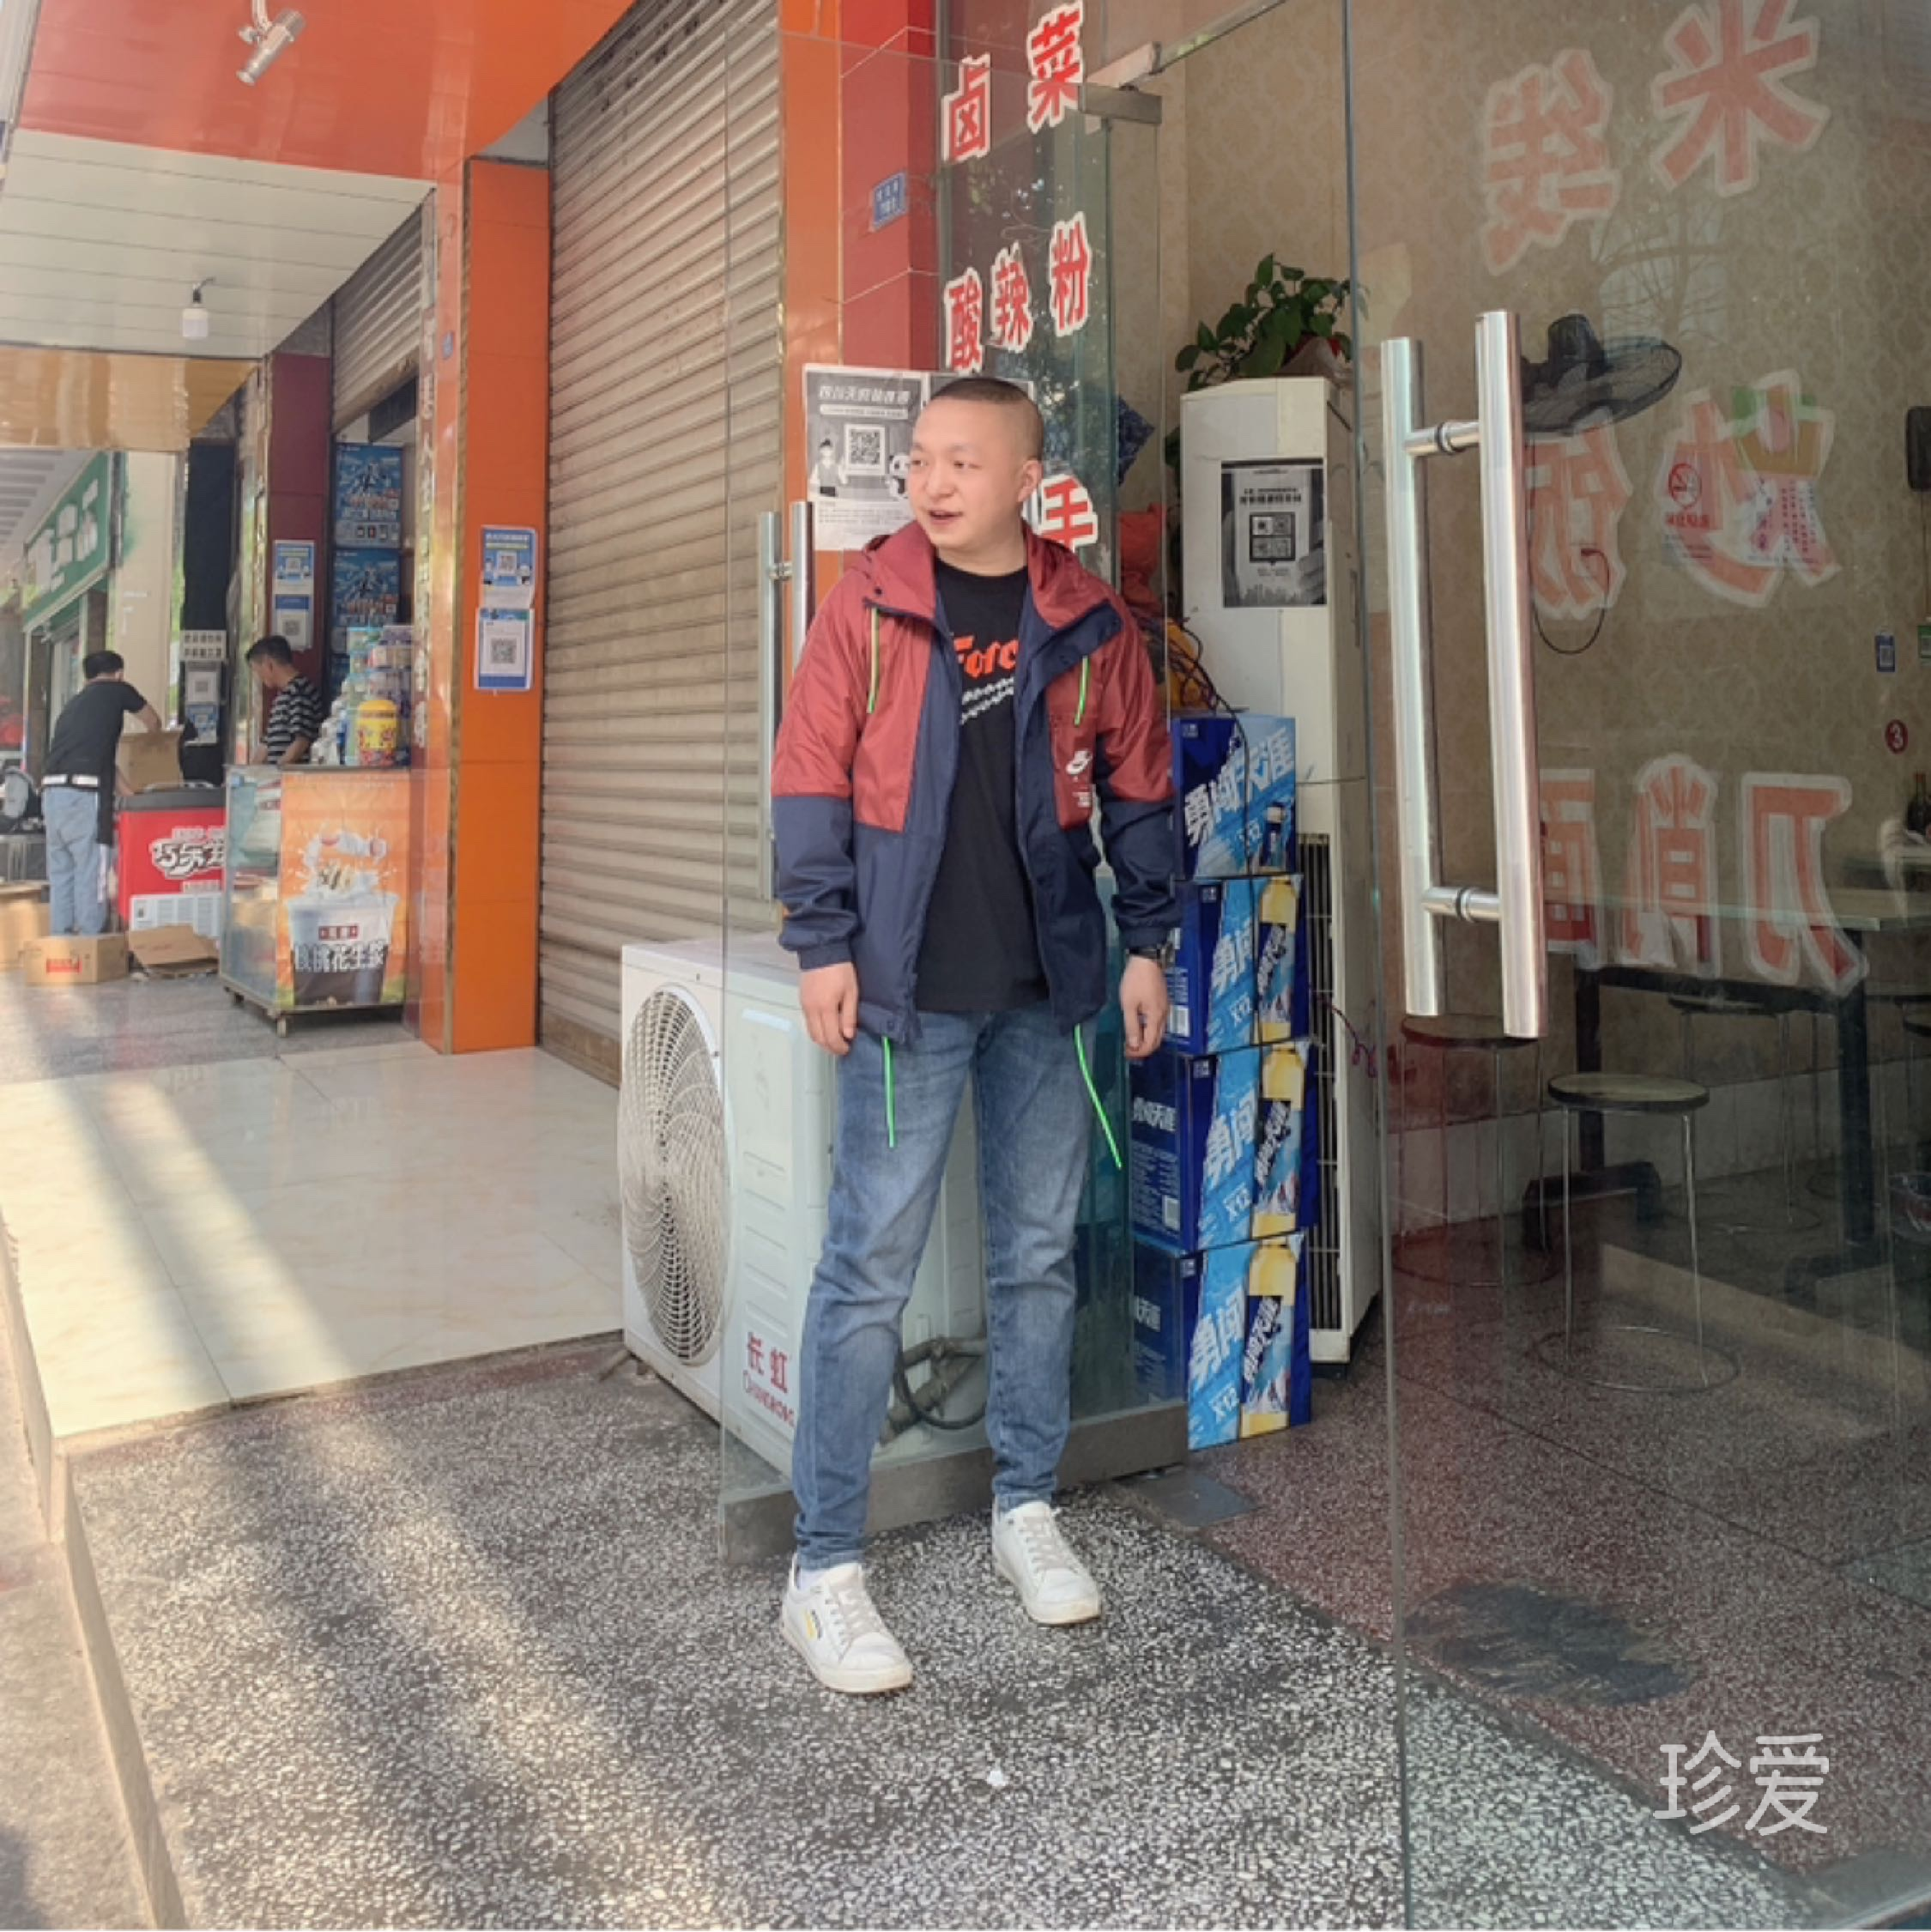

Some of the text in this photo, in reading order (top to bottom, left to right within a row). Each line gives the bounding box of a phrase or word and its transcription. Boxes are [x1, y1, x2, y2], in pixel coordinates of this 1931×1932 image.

[942, 2, 1084, 162] 卤菜
[944, 213, 1091, 375] 酸辣粉
[747, 1331, 789, 1395] 长虹
